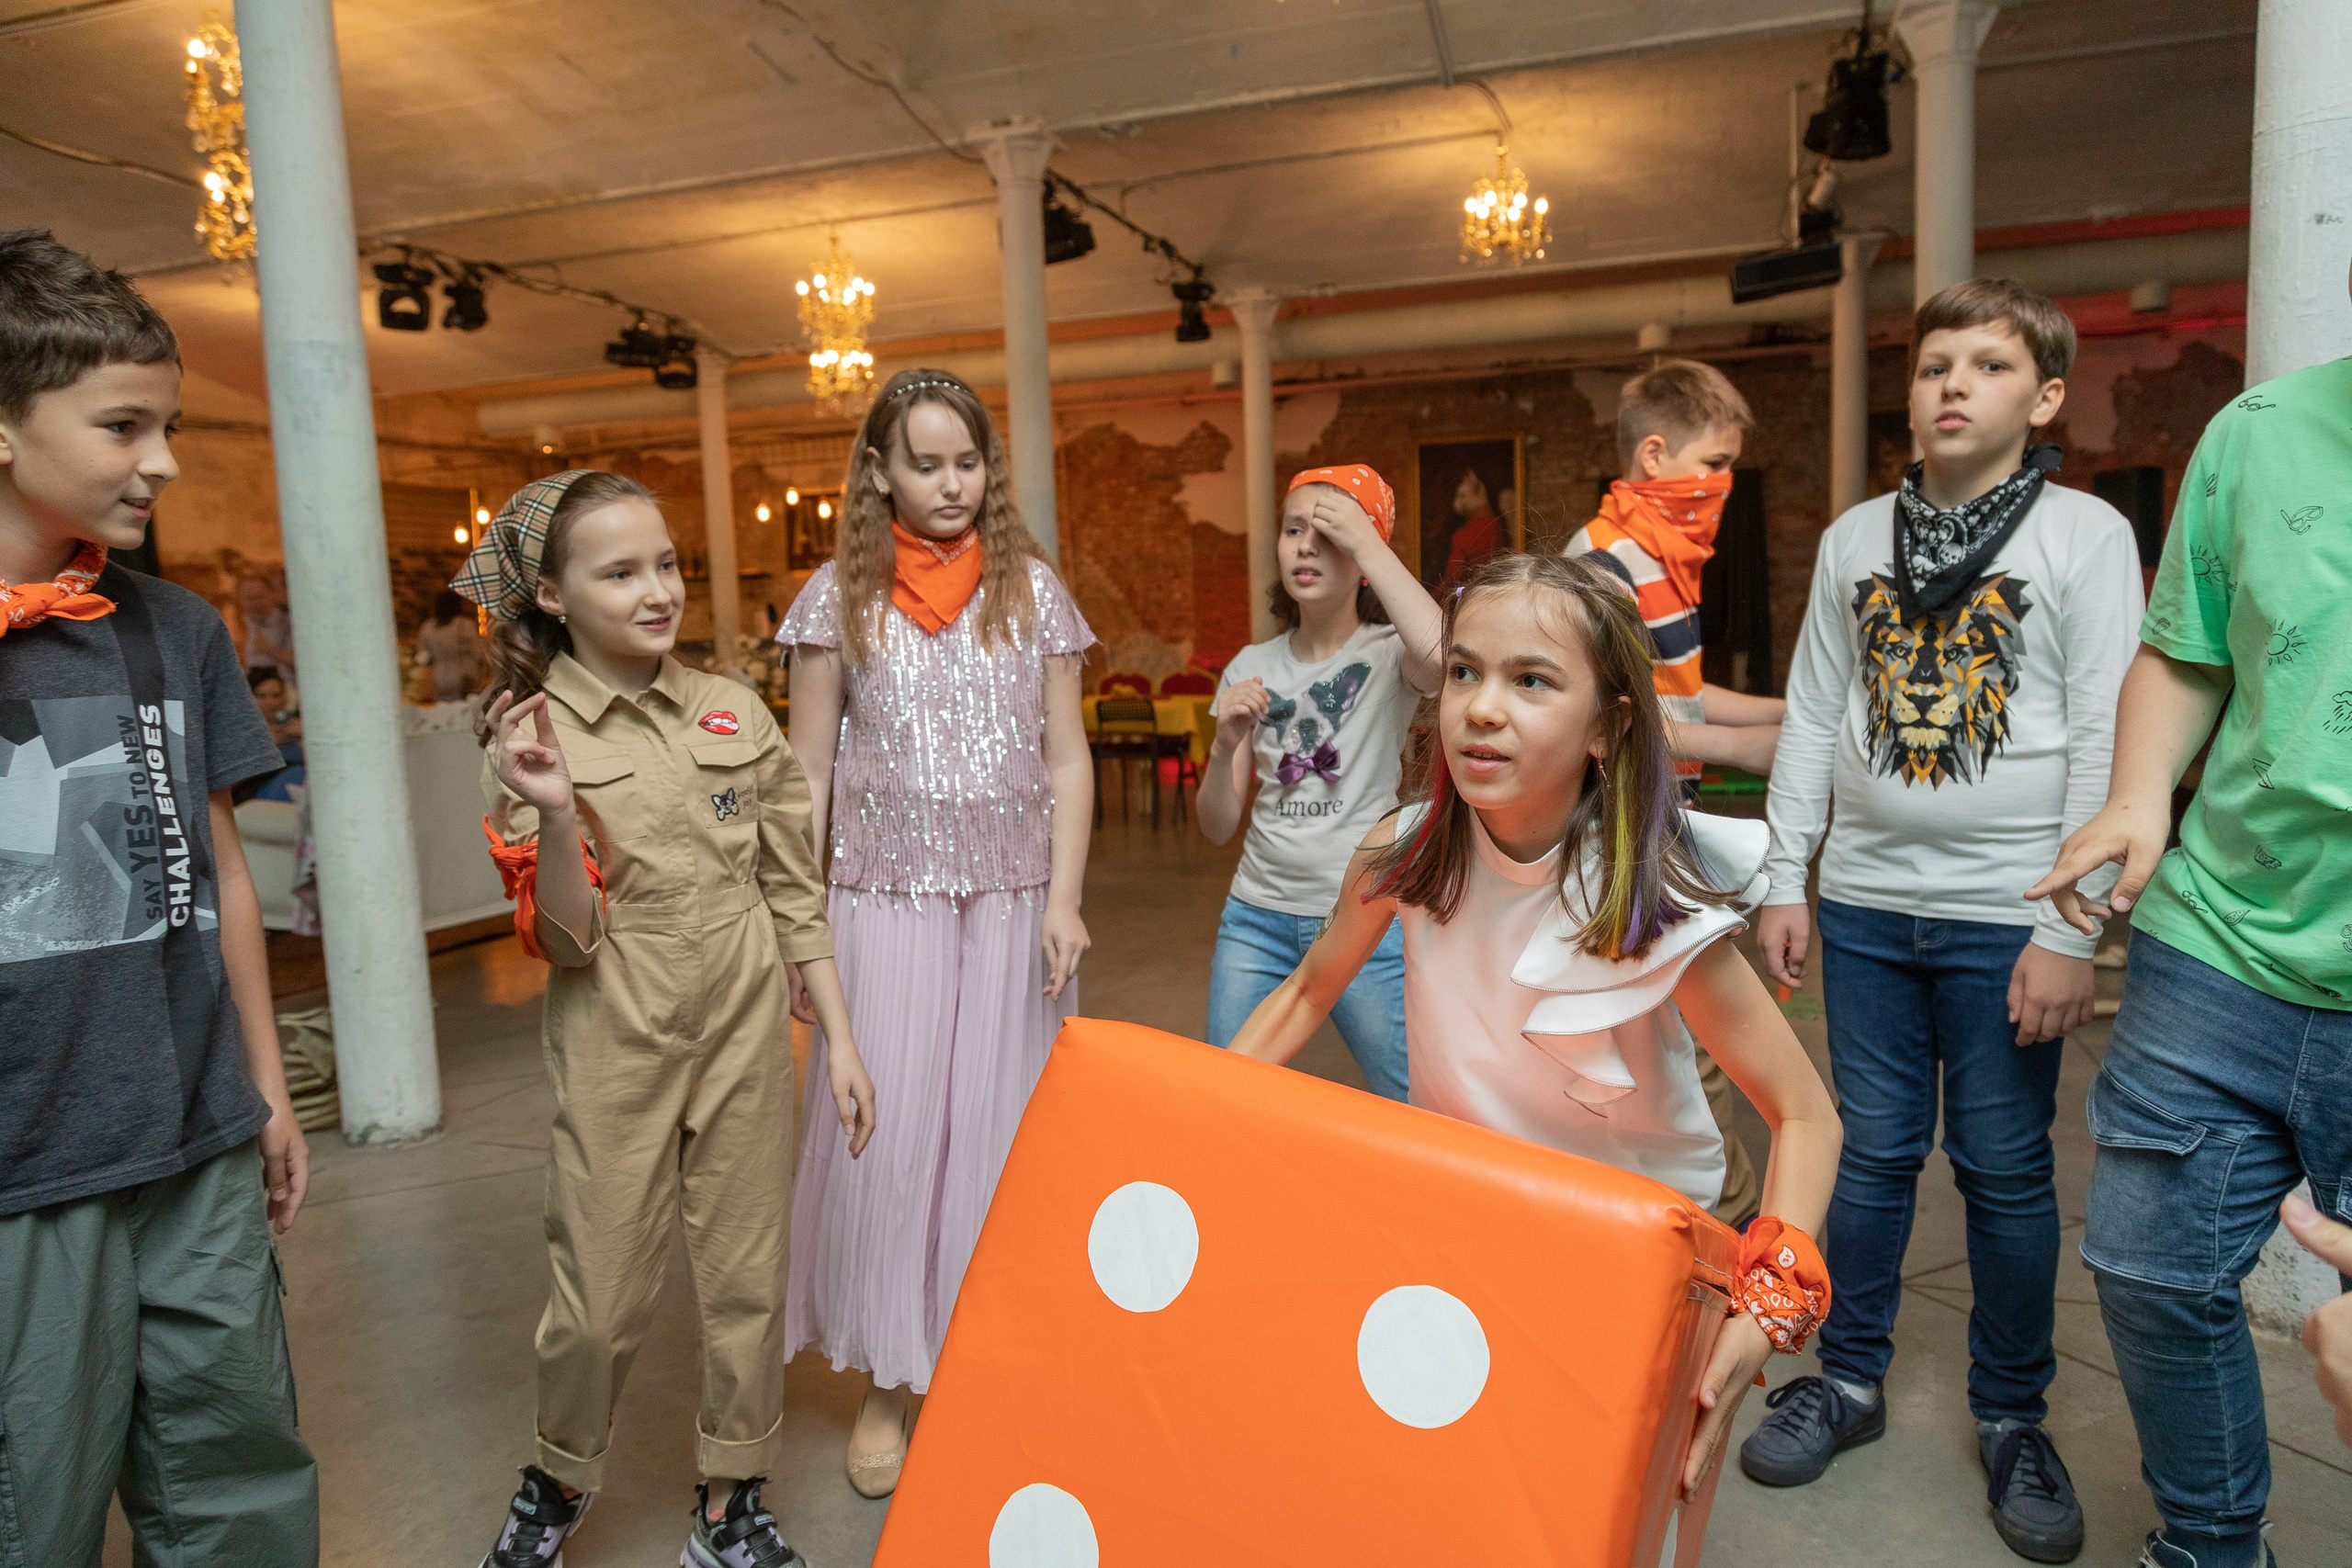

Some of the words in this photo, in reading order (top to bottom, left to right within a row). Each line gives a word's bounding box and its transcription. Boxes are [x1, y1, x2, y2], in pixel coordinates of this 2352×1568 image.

[117, 715, 143, 764] NEW
[130, 771, 150, 800] TO
[1273, 797, 1344, 817] Amore
[139, 704, 191, 928] CHALLENGES
[124, 805, 159, 874] YES
[143, 878, 164, 919] SAY
